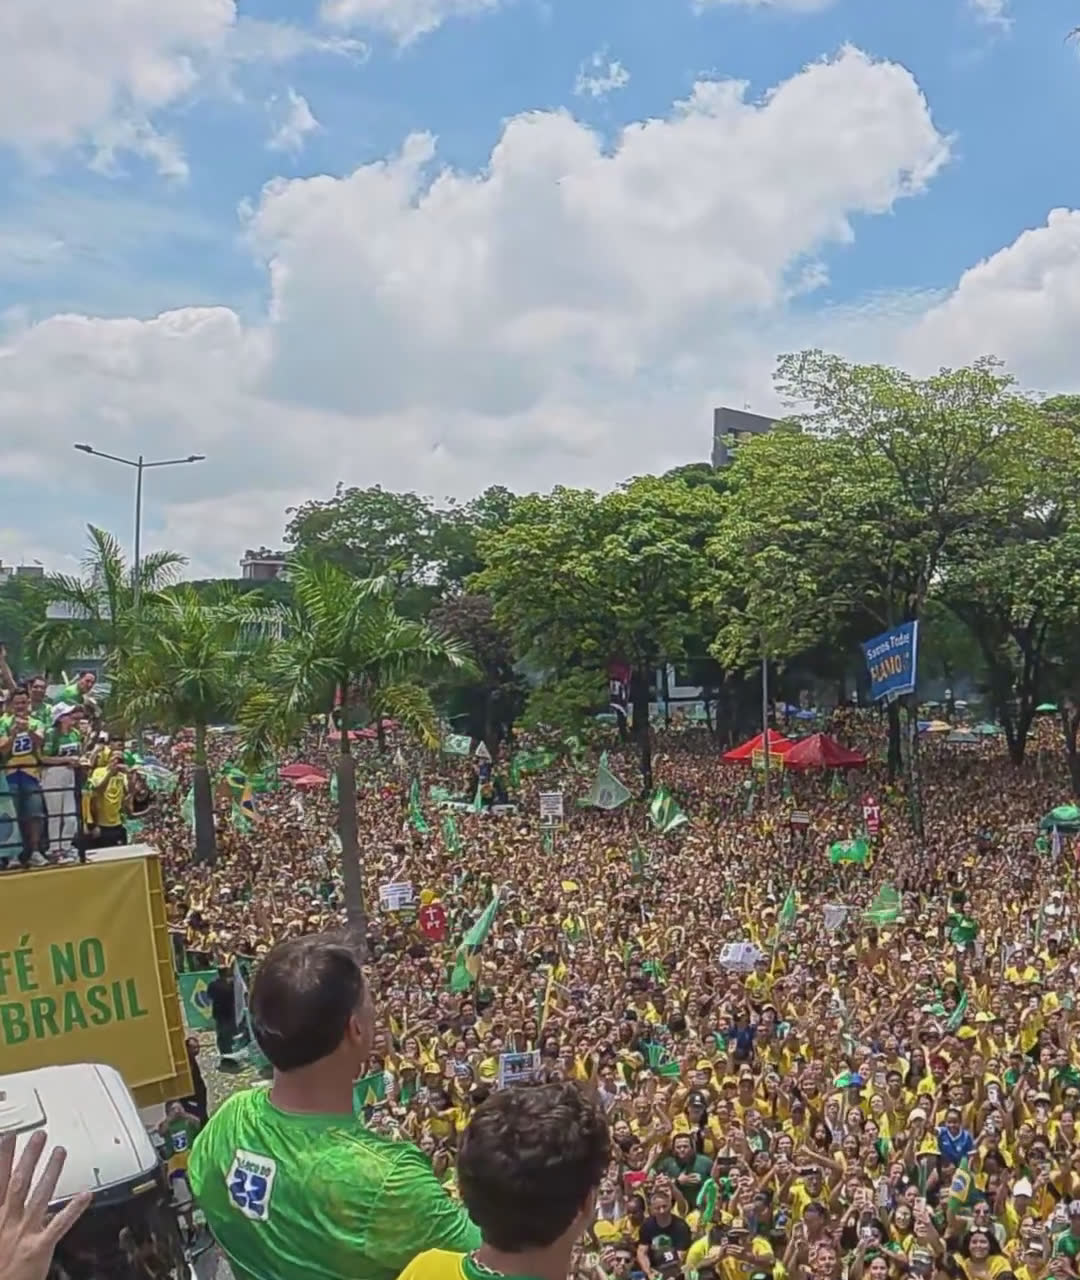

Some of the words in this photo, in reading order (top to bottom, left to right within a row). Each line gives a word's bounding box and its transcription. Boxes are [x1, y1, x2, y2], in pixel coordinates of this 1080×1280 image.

[15, 738, 31, 749] 22
[863, 805, 880, 819] PT
[0, 933, 38, 995] FÉ
[50, 937, 106, 987] NO
[1, 977, 149, 1046] BRASIL
[230, 1167, 267, 1216] 22
